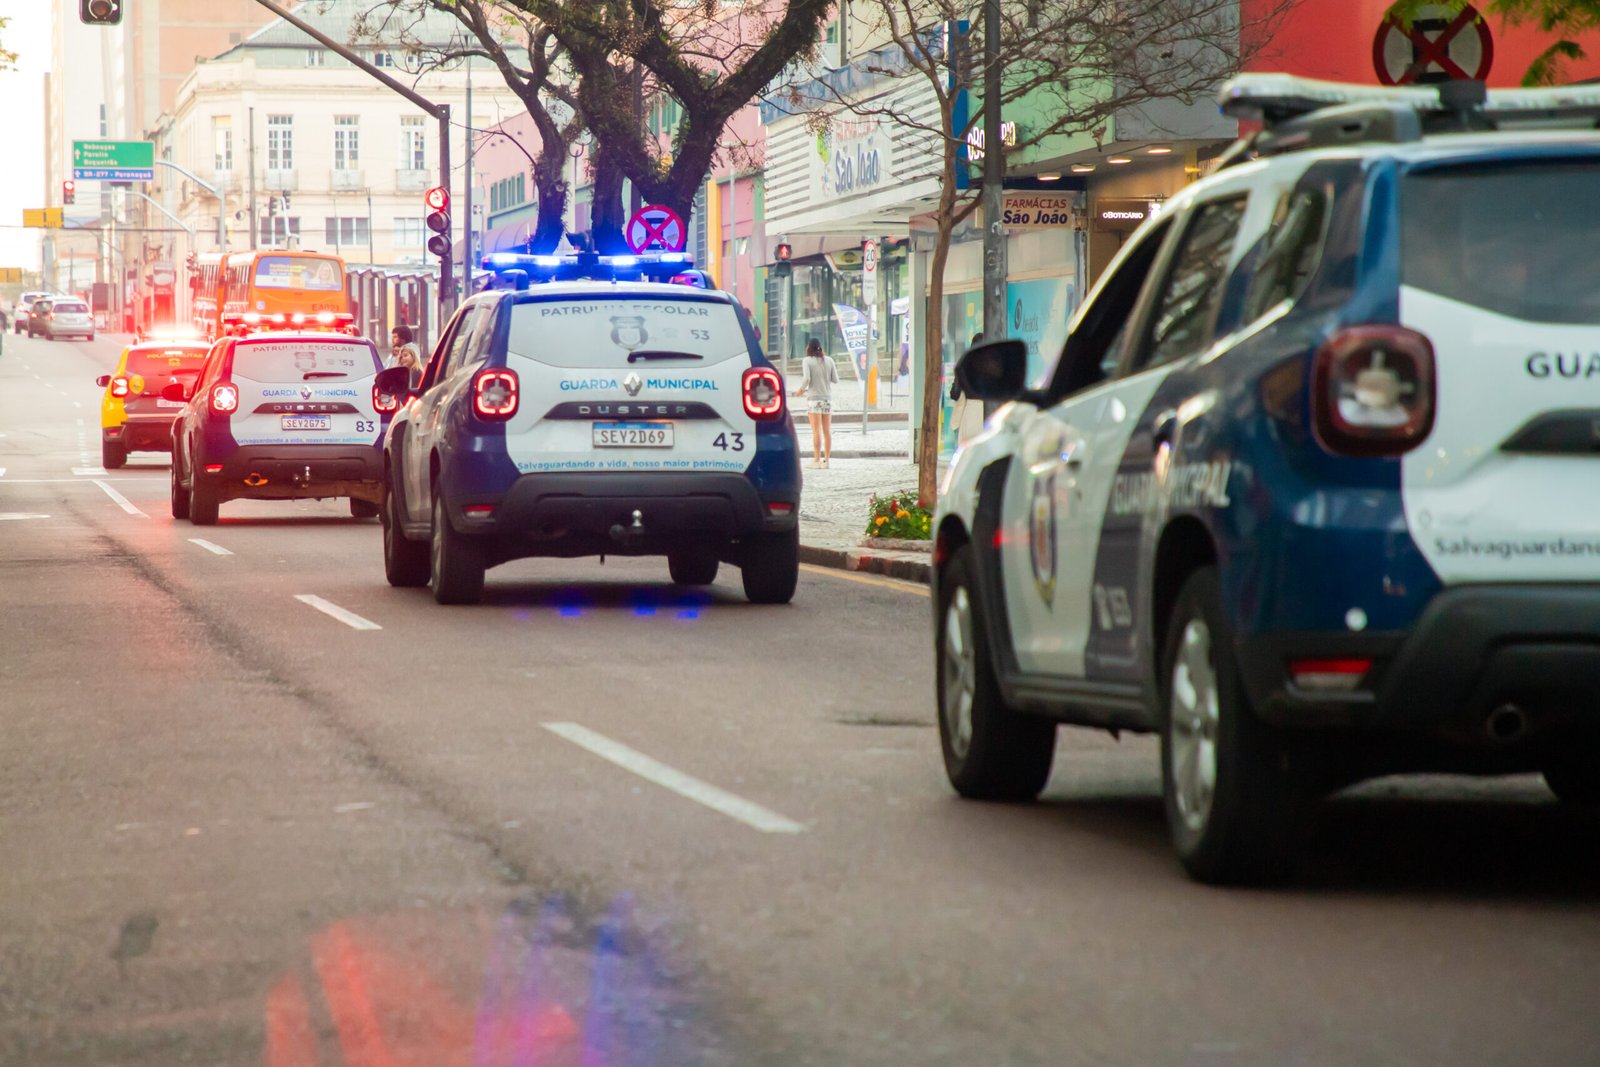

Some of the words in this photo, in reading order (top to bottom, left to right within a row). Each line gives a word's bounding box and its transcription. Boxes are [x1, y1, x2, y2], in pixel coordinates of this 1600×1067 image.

[835, 145, 854, 192] São
[855, 136, 880, 186] João
[1005, 197, 1067, 209] FARMÁCIAS
[1003, 209, 1030, 224] São
[1033, 209, 1068, 224] João
[541, 304, 624, 317] PATRU
[632, 304, 709, 317] COLAR
[560, 379, 618, 391] GUARDA
[647, 378, 719, 391] MUNICIPAL
[262, 389, 298, 397] GUARDA
[314, 388, 358, 397] MUNICIPAL
[579, 405, 687, 414] DUSTER
[356, 421, 375, 433] 83
[600, 430, 665, 444] SEY2D69
[712, 432, 745, 451] 43
[517, 459, 595, 470] Salvaguardando
[607, 459, 630, 469] vida,
[663, 460, 690, 468] maior
[693, 459, 744, 470] patrimônio
